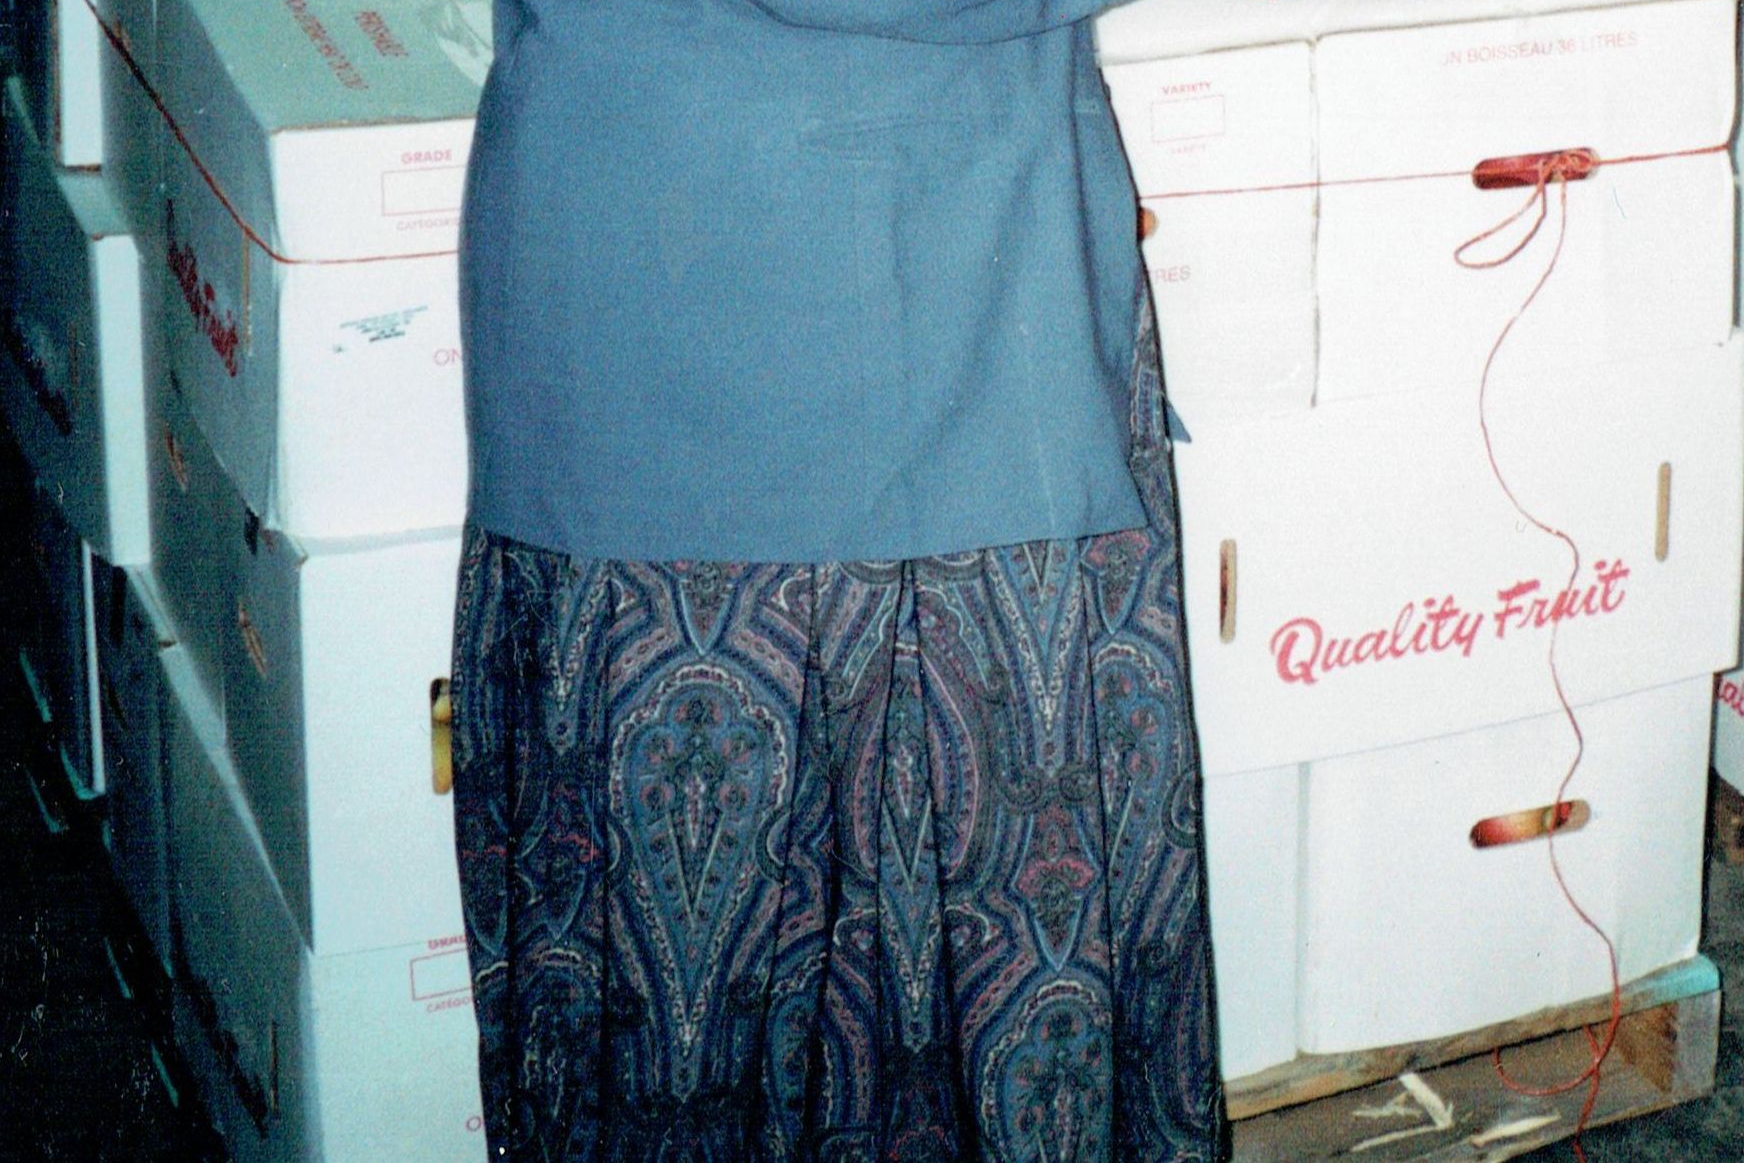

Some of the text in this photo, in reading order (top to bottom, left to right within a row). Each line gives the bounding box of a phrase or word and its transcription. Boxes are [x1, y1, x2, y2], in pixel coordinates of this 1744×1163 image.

[1467, 43, 1551, 64] BOISSEAU
[1556, 38, 1576, 54] 36
[1579, 31, 1639, 55] LITRES
[1162, 82, 1212, 95] VARIETY
[401, 150, 452, 165] GRADE
[1271, 558, 1631, 685] Quality Fruit
